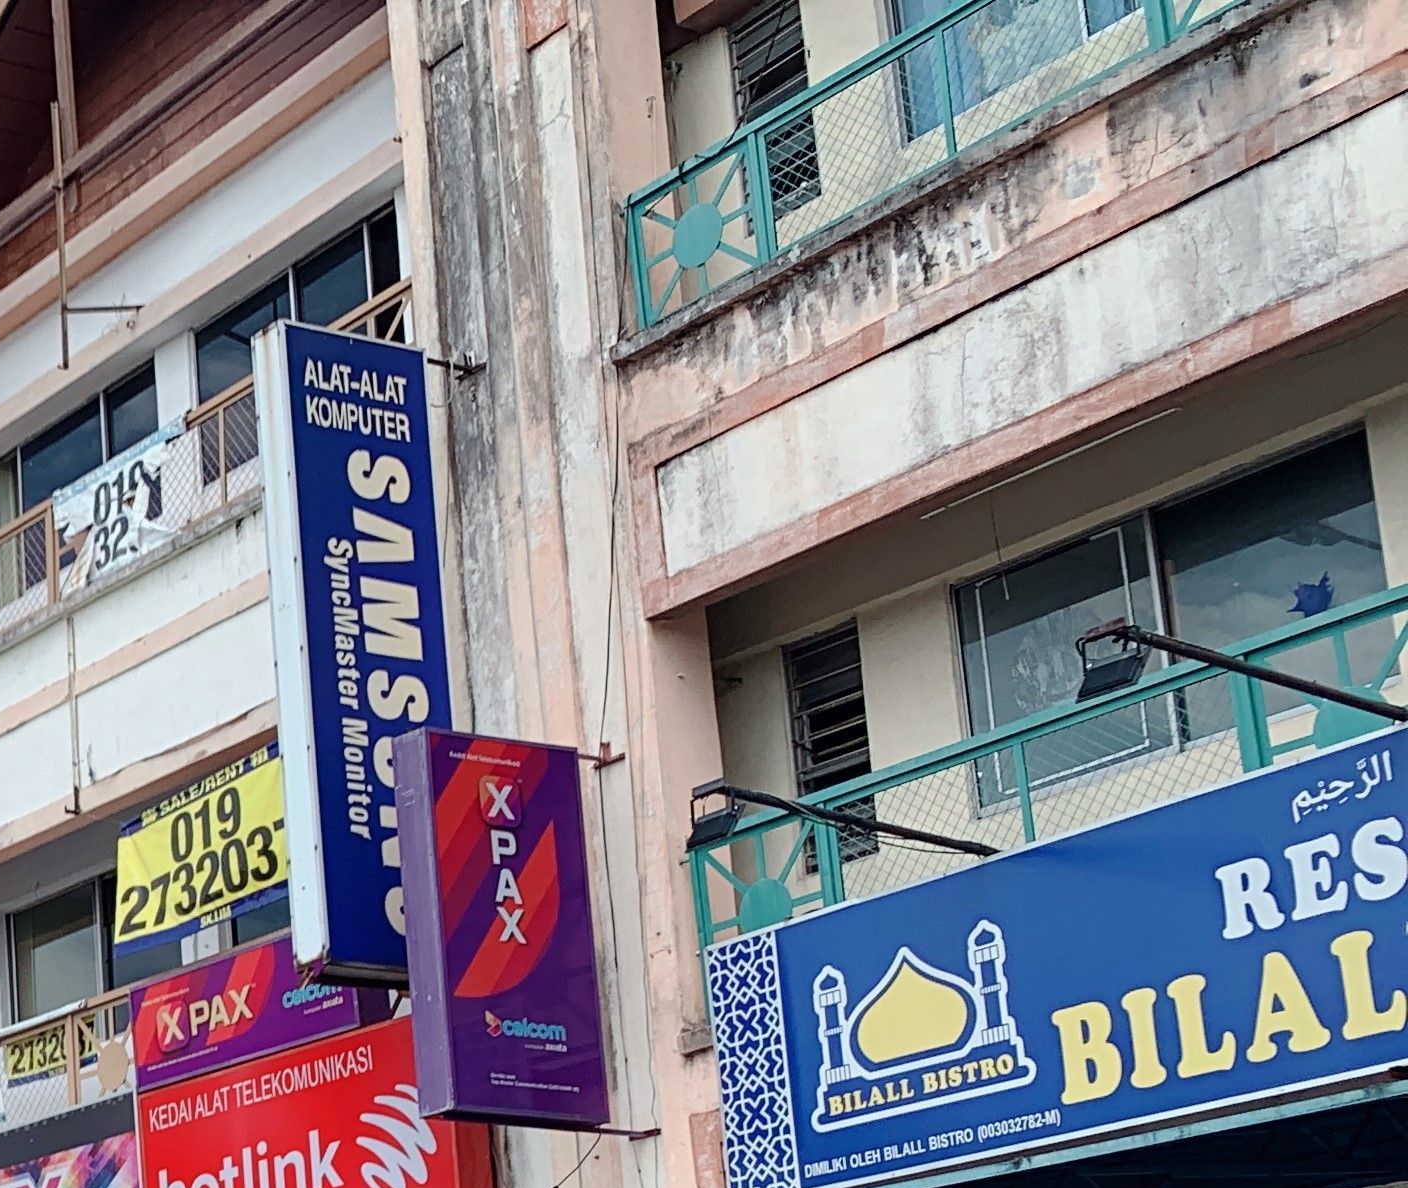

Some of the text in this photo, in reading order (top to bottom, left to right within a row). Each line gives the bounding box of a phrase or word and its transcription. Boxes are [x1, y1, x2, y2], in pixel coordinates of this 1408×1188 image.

[304, 356, 407, 405] ALAT-ALAT
[306, 394, 411, 443] KOMPUTER
[327, 537, 371, 841] SyncMaster Monitor
[170, 787, 242, 863] 019
[119, 817, 284, 936] 273203
[1215, 816, 1408, 941] RES
[501, 1017, 567, 1042] celcom
[1050, 929, 1407, 1104] BILAL
[148, 1094, 193, 1133] KEDAI
[194, 1088, 232, 1122] ALAT
[232, 1045, 374, 1108] TELEKOMUNIKASI
[828, 1053, 1015, 1116] BILALL BISTRO
[804, 1159, 847, 1179] DIMILIKI
[850, 1150, 882, 1168] OLEH
[884, 1140, 927, 1161] BILALL
[928, 1127, 974, 1151] BISTRO
